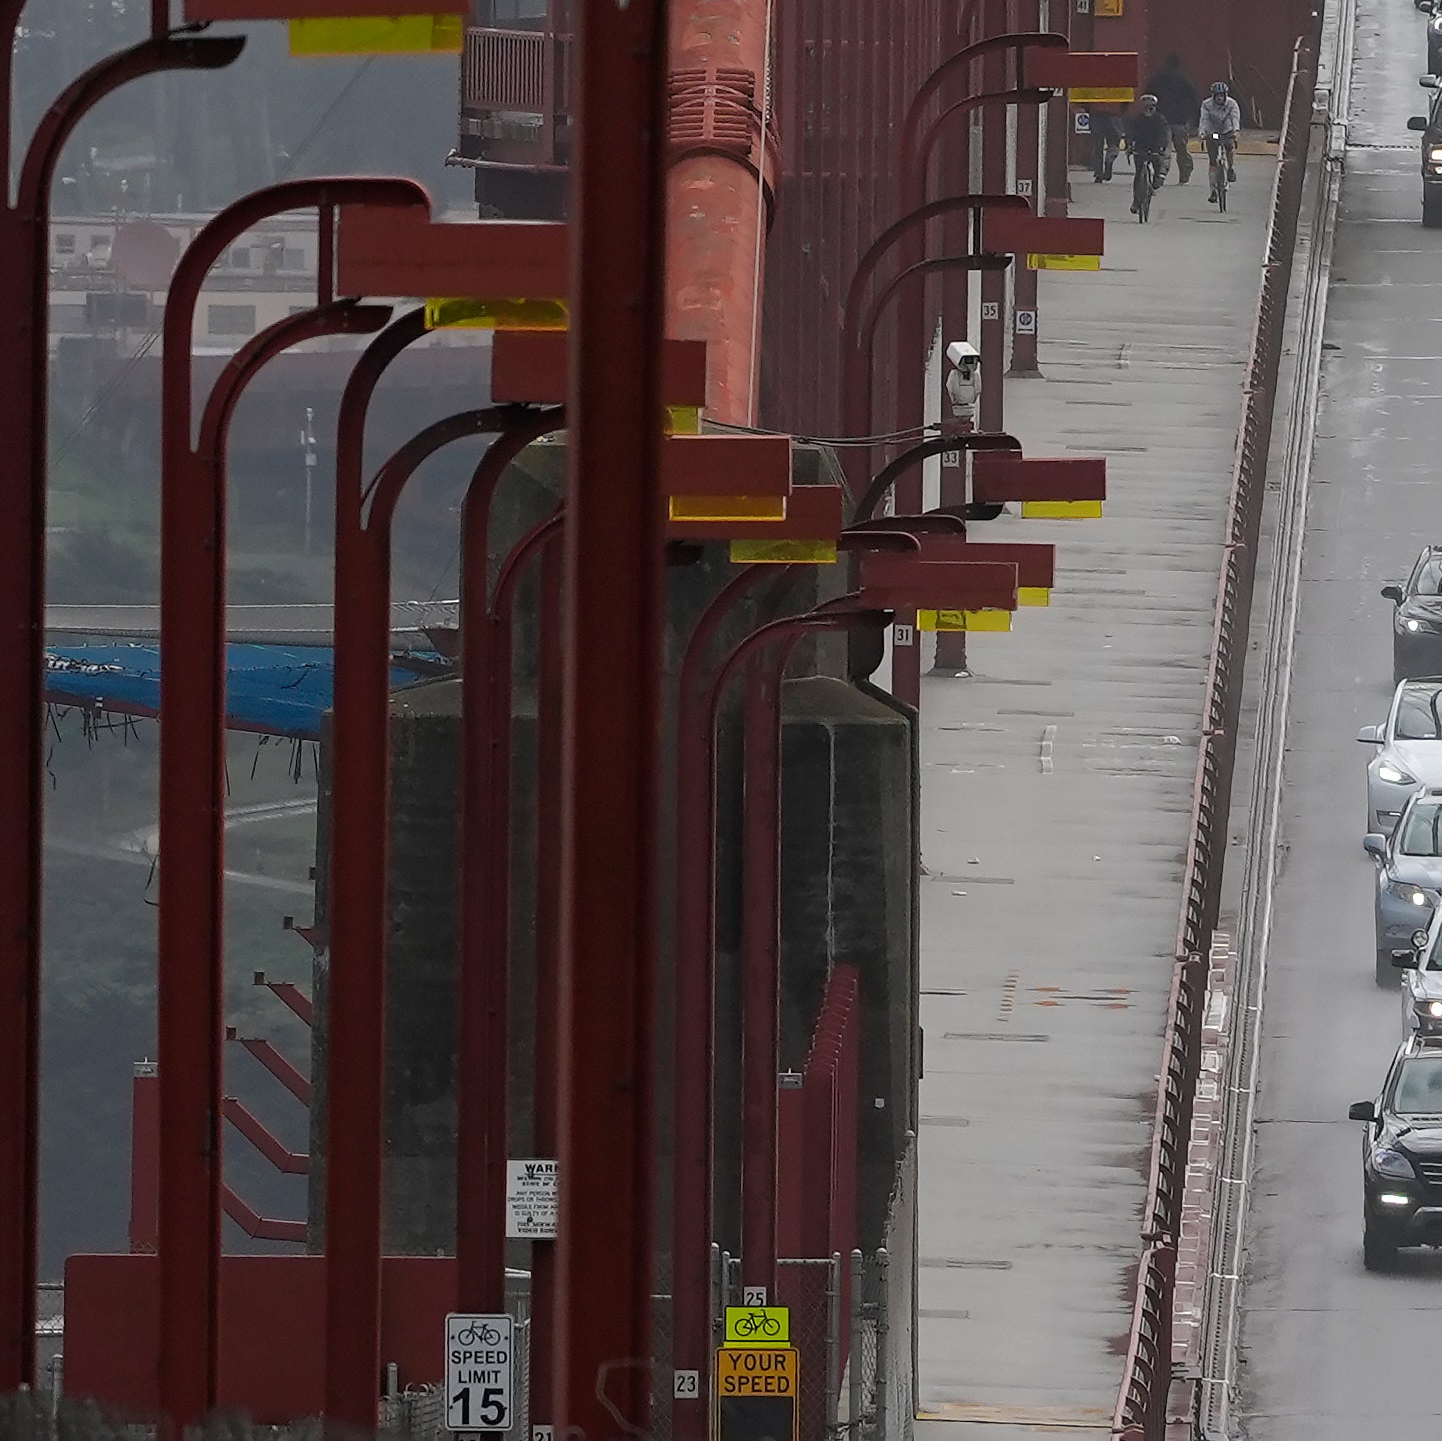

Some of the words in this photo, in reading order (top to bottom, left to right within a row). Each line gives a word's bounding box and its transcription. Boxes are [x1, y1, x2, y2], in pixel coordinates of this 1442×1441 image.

[1019, 182, 1030, 193] 37
[984, 305, 996, 316] 35
[944, 452, 957, 463] 33
[897, 628, 909, 641] 31
[746, 1292, 764, 1306] 25
[451, 1351, 507, 1364] SPEED
[728, 1354, 786, 1371] YOUR
[458, 1370, 501, 1383] LIMIT
[677, 1375, 696, 1392] 23
[724, 1376, 789, 1393] SPEED
[452, 1388, 506, 1425] 15
